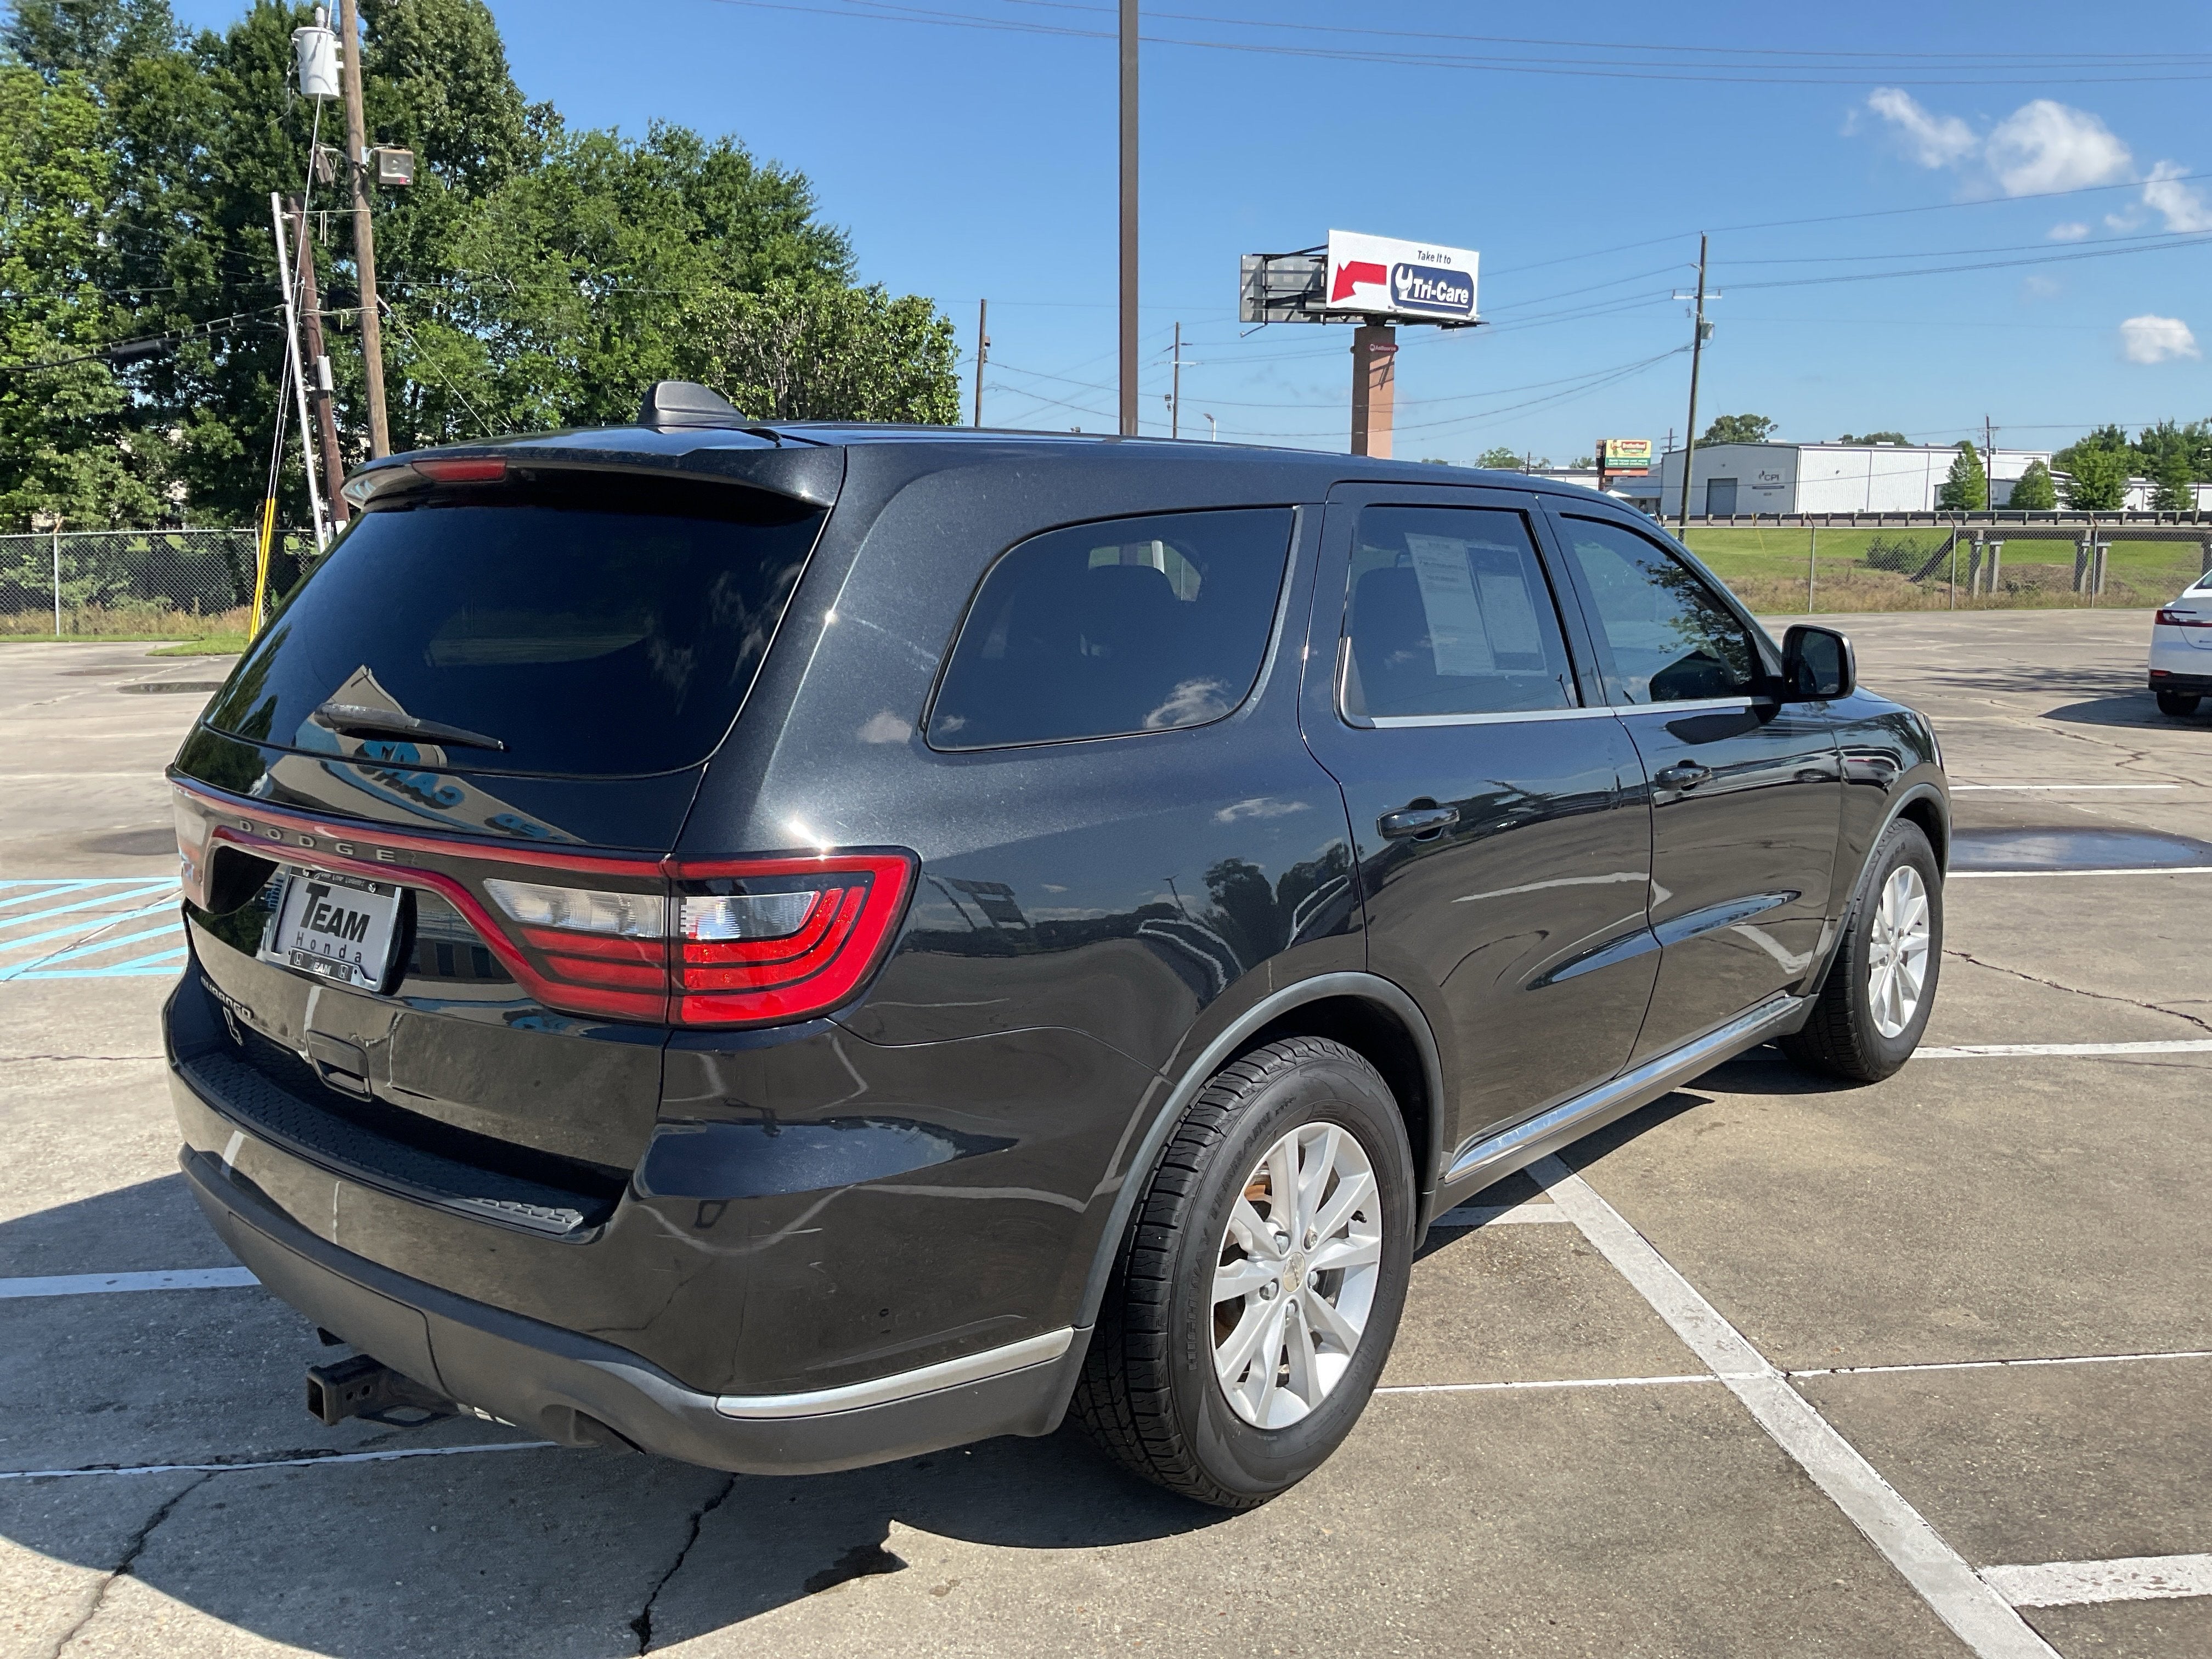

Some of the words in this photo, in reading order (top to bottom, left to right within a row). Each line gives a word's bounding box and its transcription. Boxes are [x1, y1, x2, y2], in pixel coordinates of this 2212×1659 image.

[1418, 250, 1435, 262] Take
[1444, 255, 1451, 264] to
[1413, 278, 1469, 304] Tri-Care
[239, 819, 395, 862] DODGE
[300, 882, 370, 943] TEAM
[296, 931, 362, 963] Honda
[200, 976, 252, 1020] DURANGO
